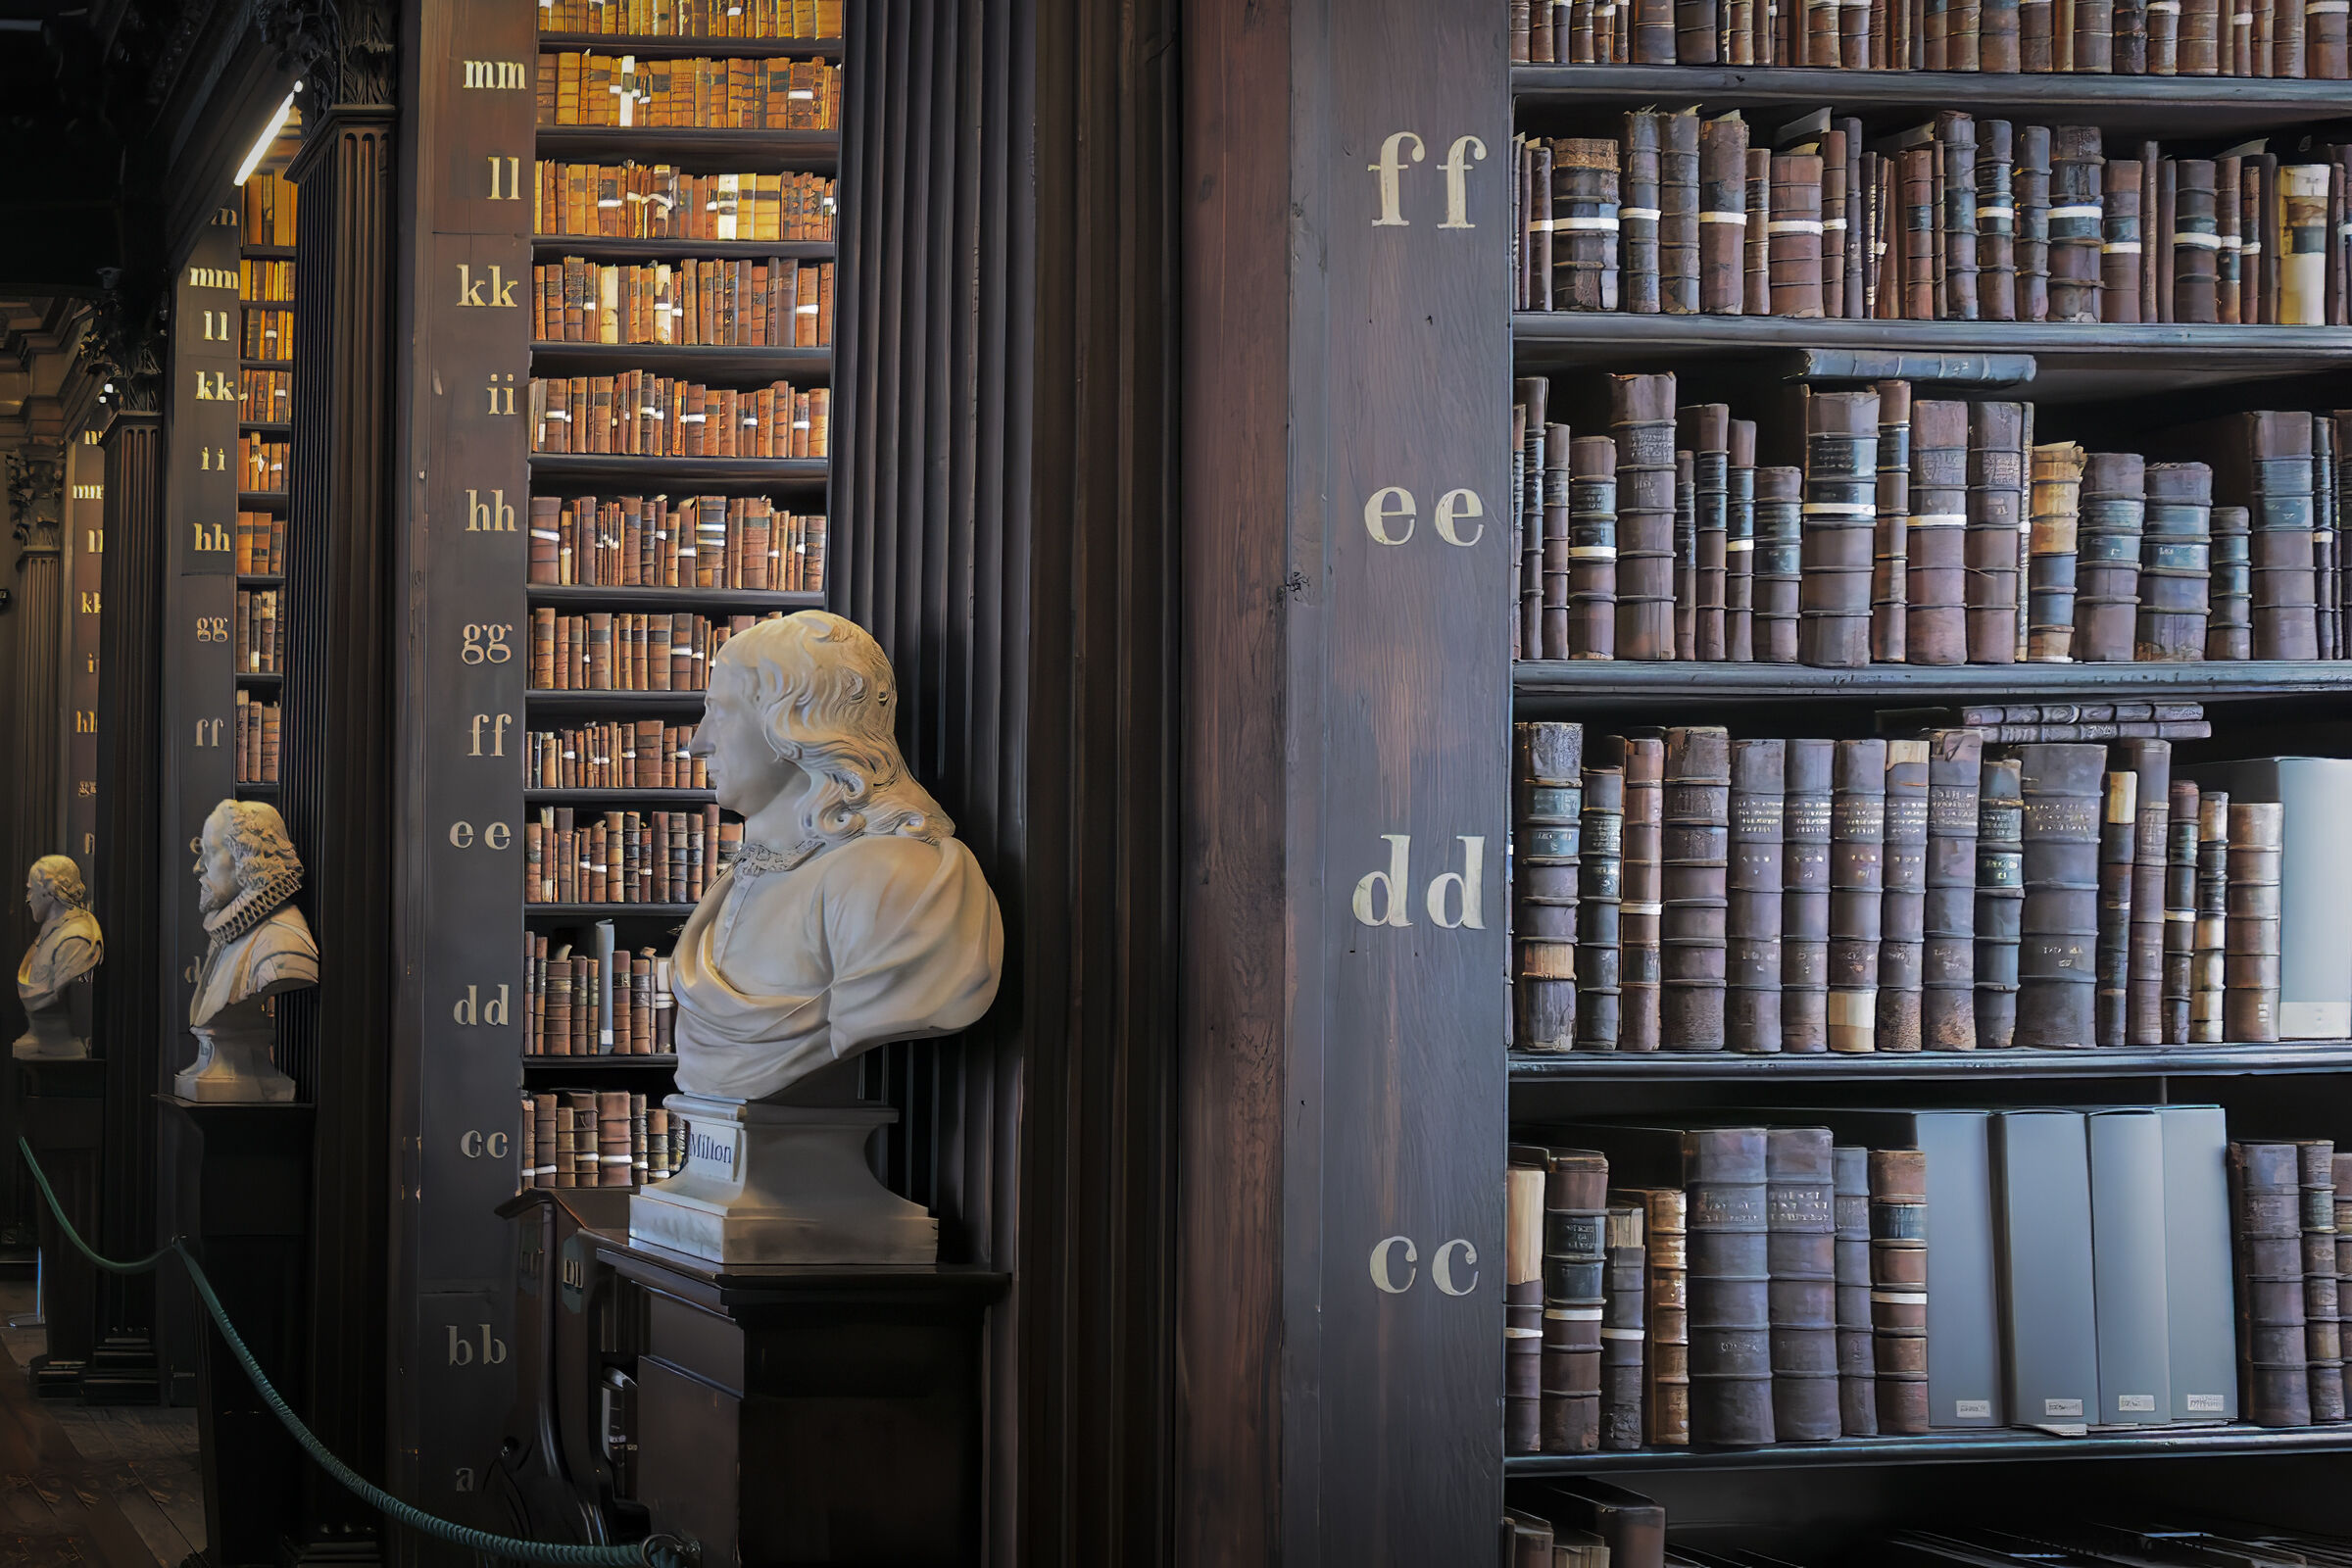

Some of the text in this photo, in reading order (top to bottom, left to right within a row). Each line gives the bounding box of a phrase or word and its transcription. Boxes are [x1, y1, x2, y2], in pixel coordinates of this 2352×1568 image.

[464, 61, 526, 89] mm
[488, 157, 521, 200] ll
[1367, 131, 1487, 230] ff
[189, 268, 239, 290] mm
[457, 265, 518, 308] kk
[204, 311, 229, 341] ll
[196, 371, 235, 401] kk
[487, 374, 517, 416] ii
[201, 447, 225, 471] ii
[466, 490, 518, 532] hh
[1364, 486, 1485, 547] ee
[194, 523, 231, 551] hh
[196, 616, 228, 643] gg
[462, 623, 513, 664] gg
[466, 713, 513, 757] ff
[449, 821, 512, 850] ee
[1351, 834, 1487, 930] dd
[454, 984, 510, 1026] dd
[461, 1129, 509, 1158] cc
[689, 1133, 732, 1164] Milton
[1369, 1235, 1481, 1297] cc
[446, 1324, 507, 1366] bb
